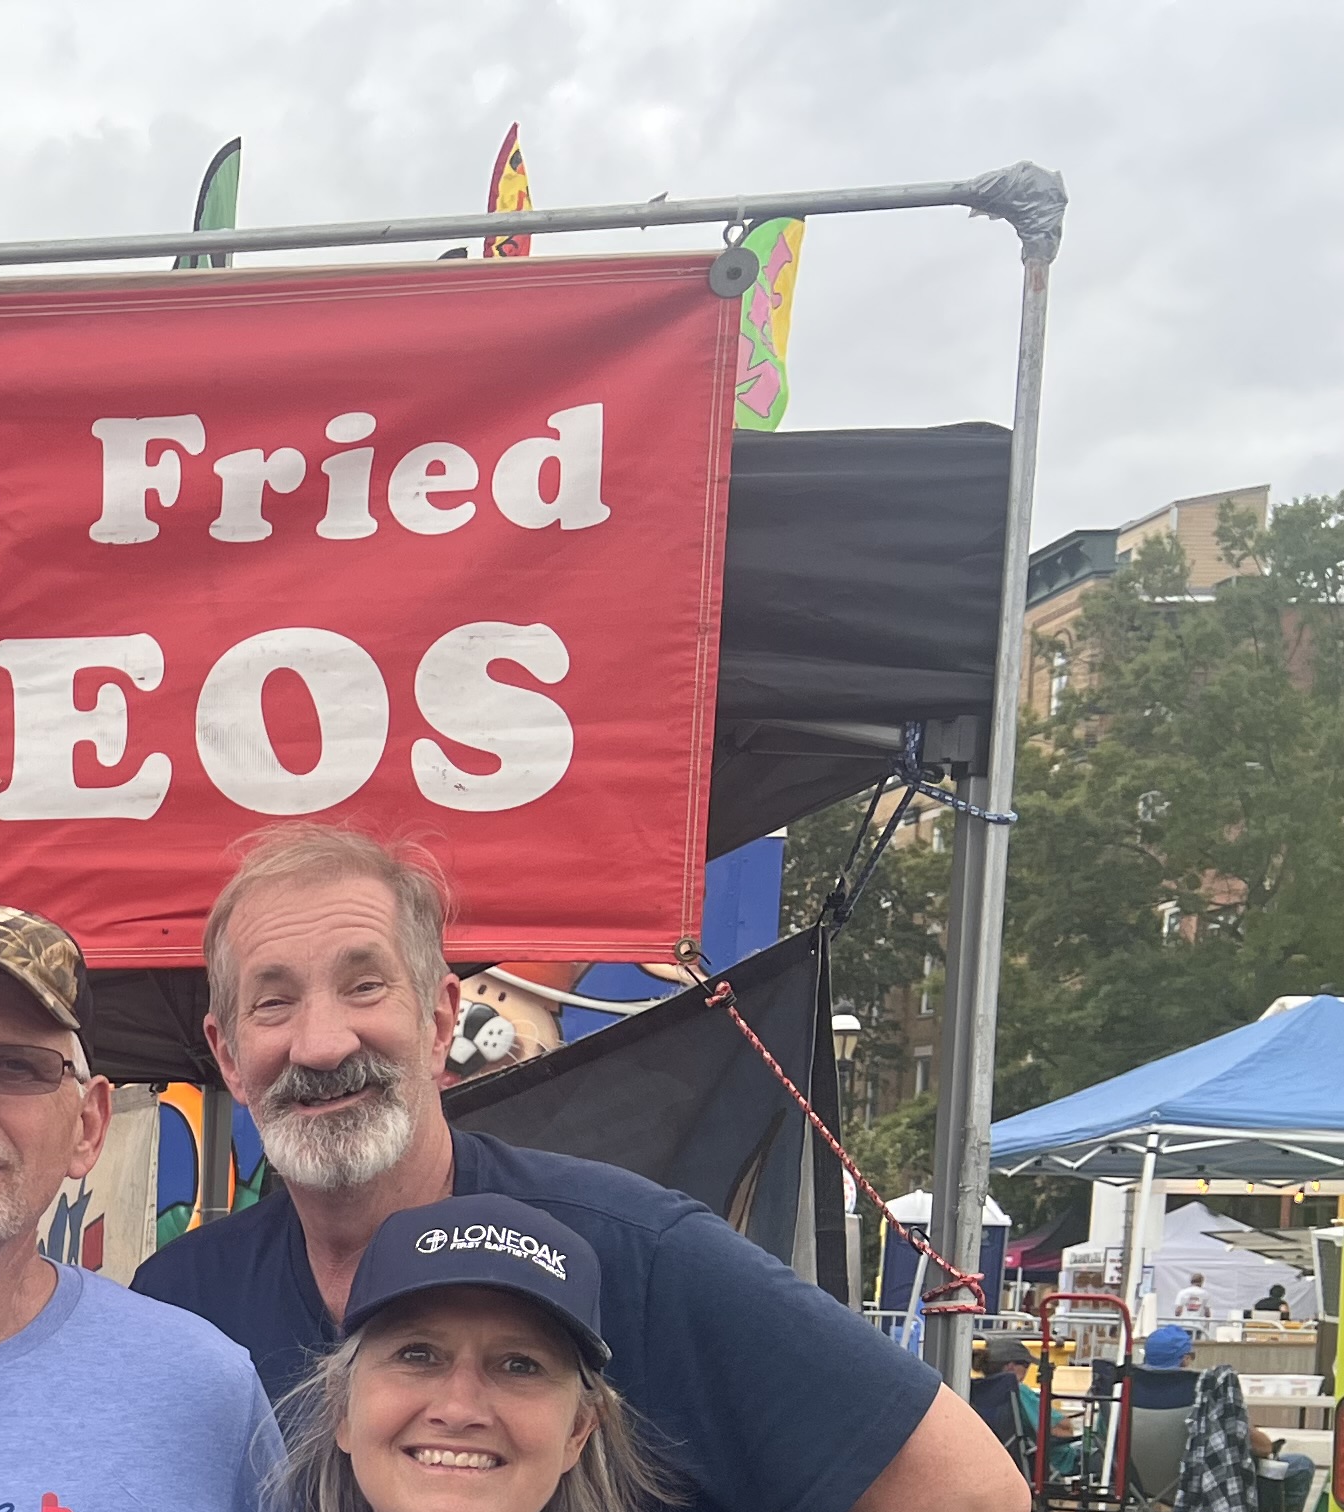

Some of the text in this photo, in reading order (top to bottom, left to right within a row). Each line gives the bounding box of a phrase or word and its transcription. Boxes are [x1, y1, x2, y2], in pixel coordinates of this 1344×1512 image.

[88, 402, 612, 545] Fried
[450, 1241, 482, 1250] FIRST
[484, 1242, 529, 1259] BAPTIST
